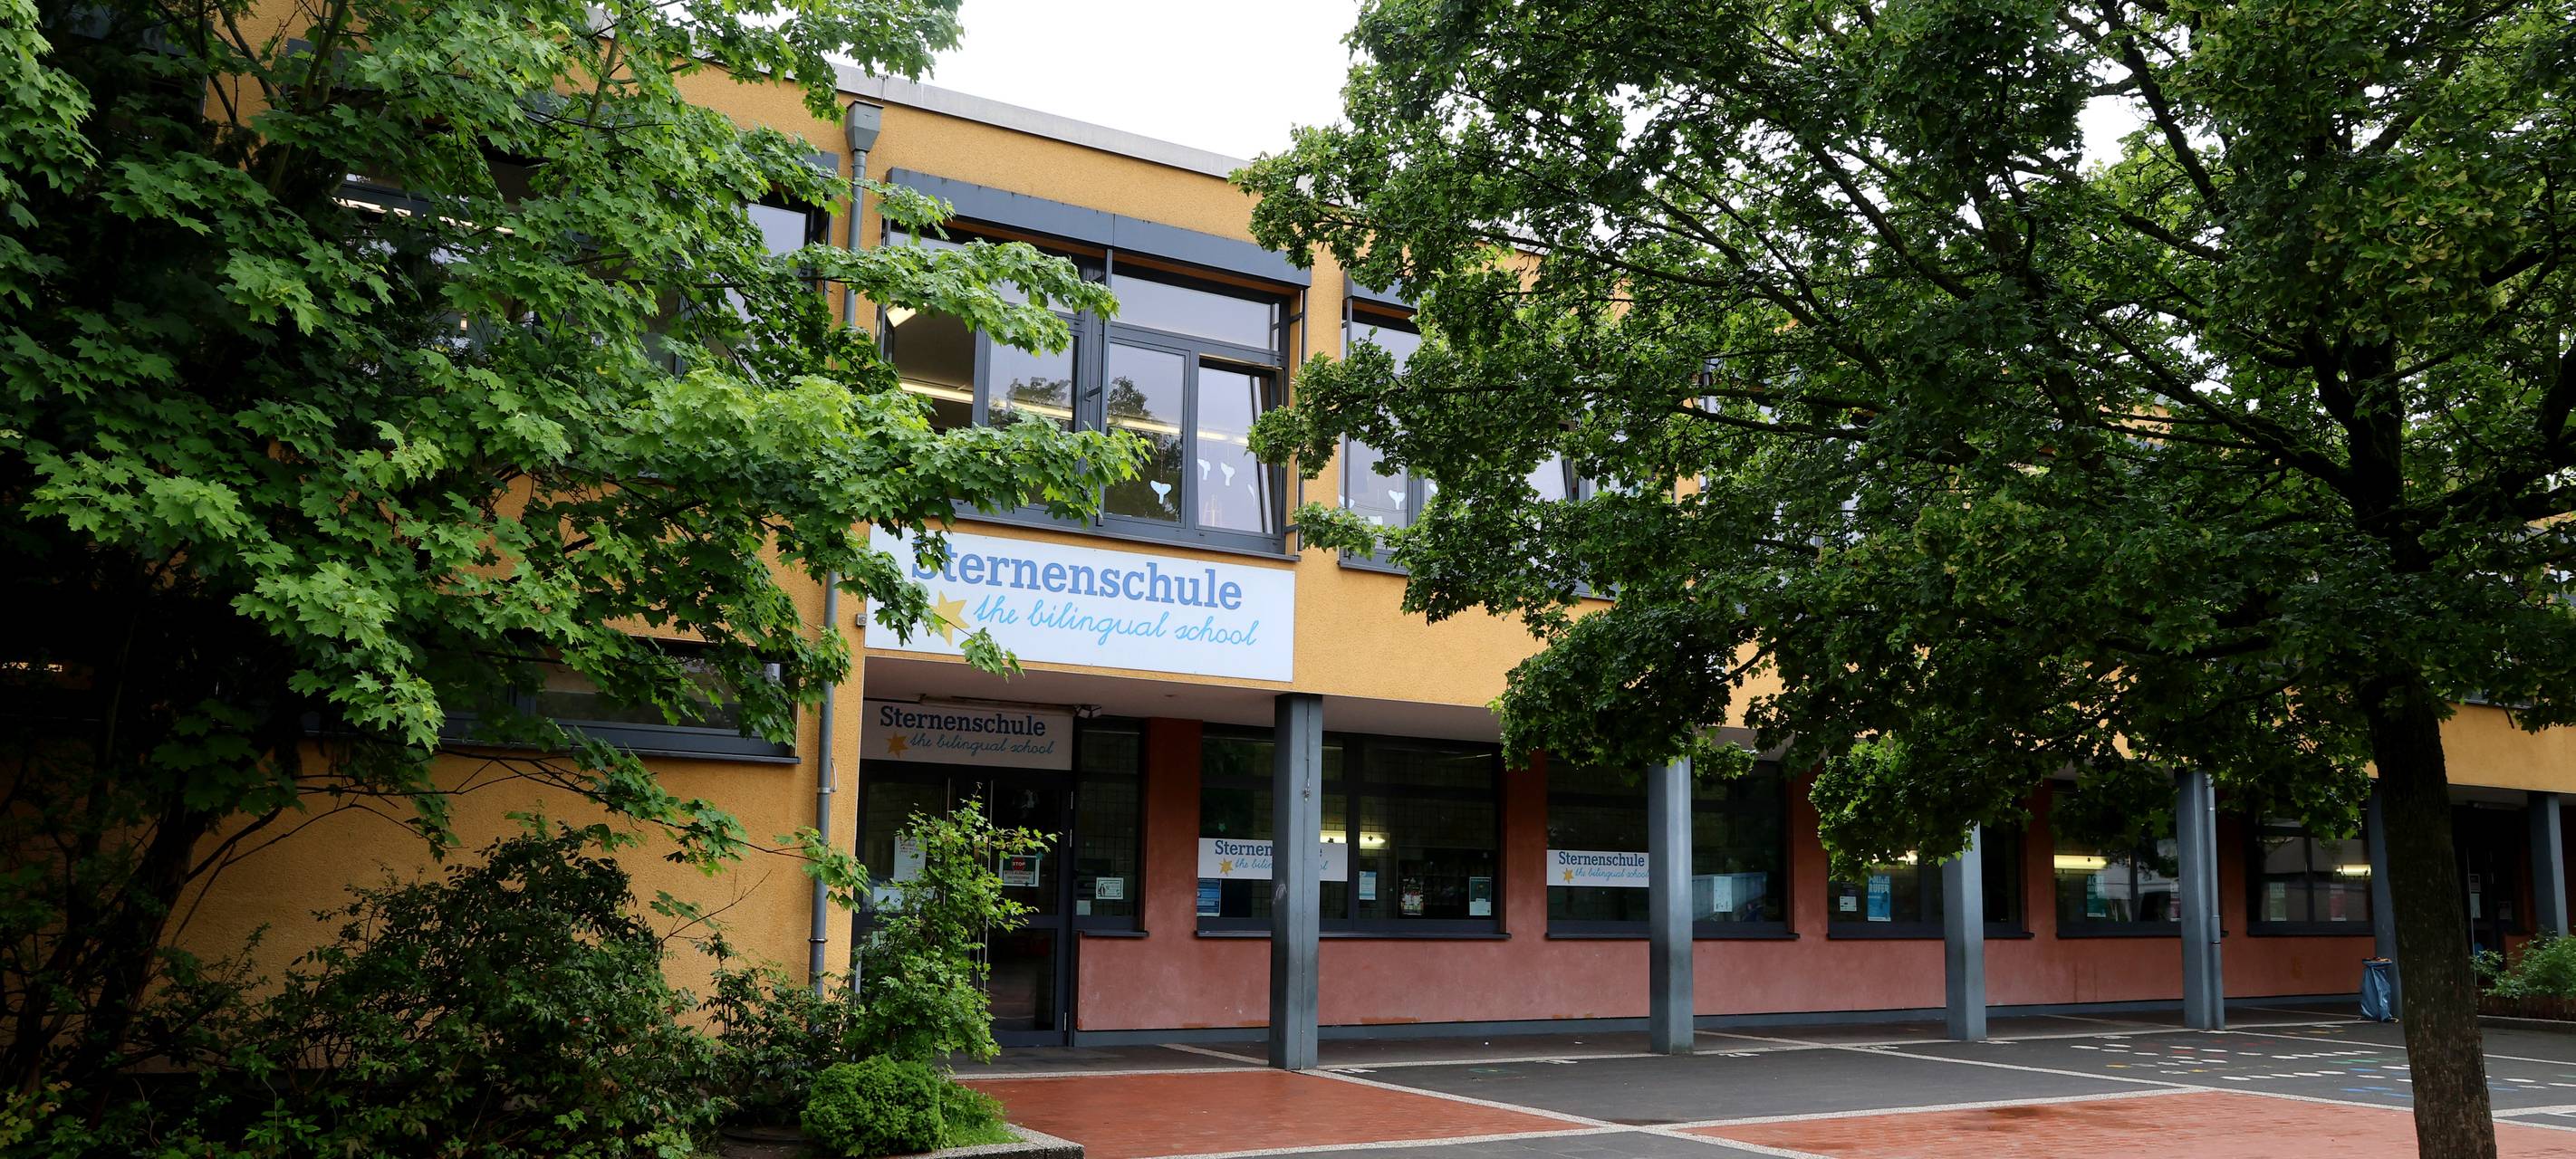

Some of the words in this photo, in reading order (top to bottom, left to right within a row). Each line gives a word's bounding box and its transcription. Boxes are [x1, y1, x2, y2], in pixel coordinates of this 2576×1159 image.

[973, 594, 1020, 626] the
[1028, 599, 1169, 646] bilingual
[1174, 615, 1260, 647] school
[880, 705, 1046, 736] Sternenschule
[909, 733, 933, 747] the
[937, 734, 1007, 756] bilingual
[1010, 740, 1055, 754] school
[1215, 839, 1273, 857] Sternen
[1559, 851, 1645, 867] Sternenschule
[1588, 867, 1624, 881] bilingual
